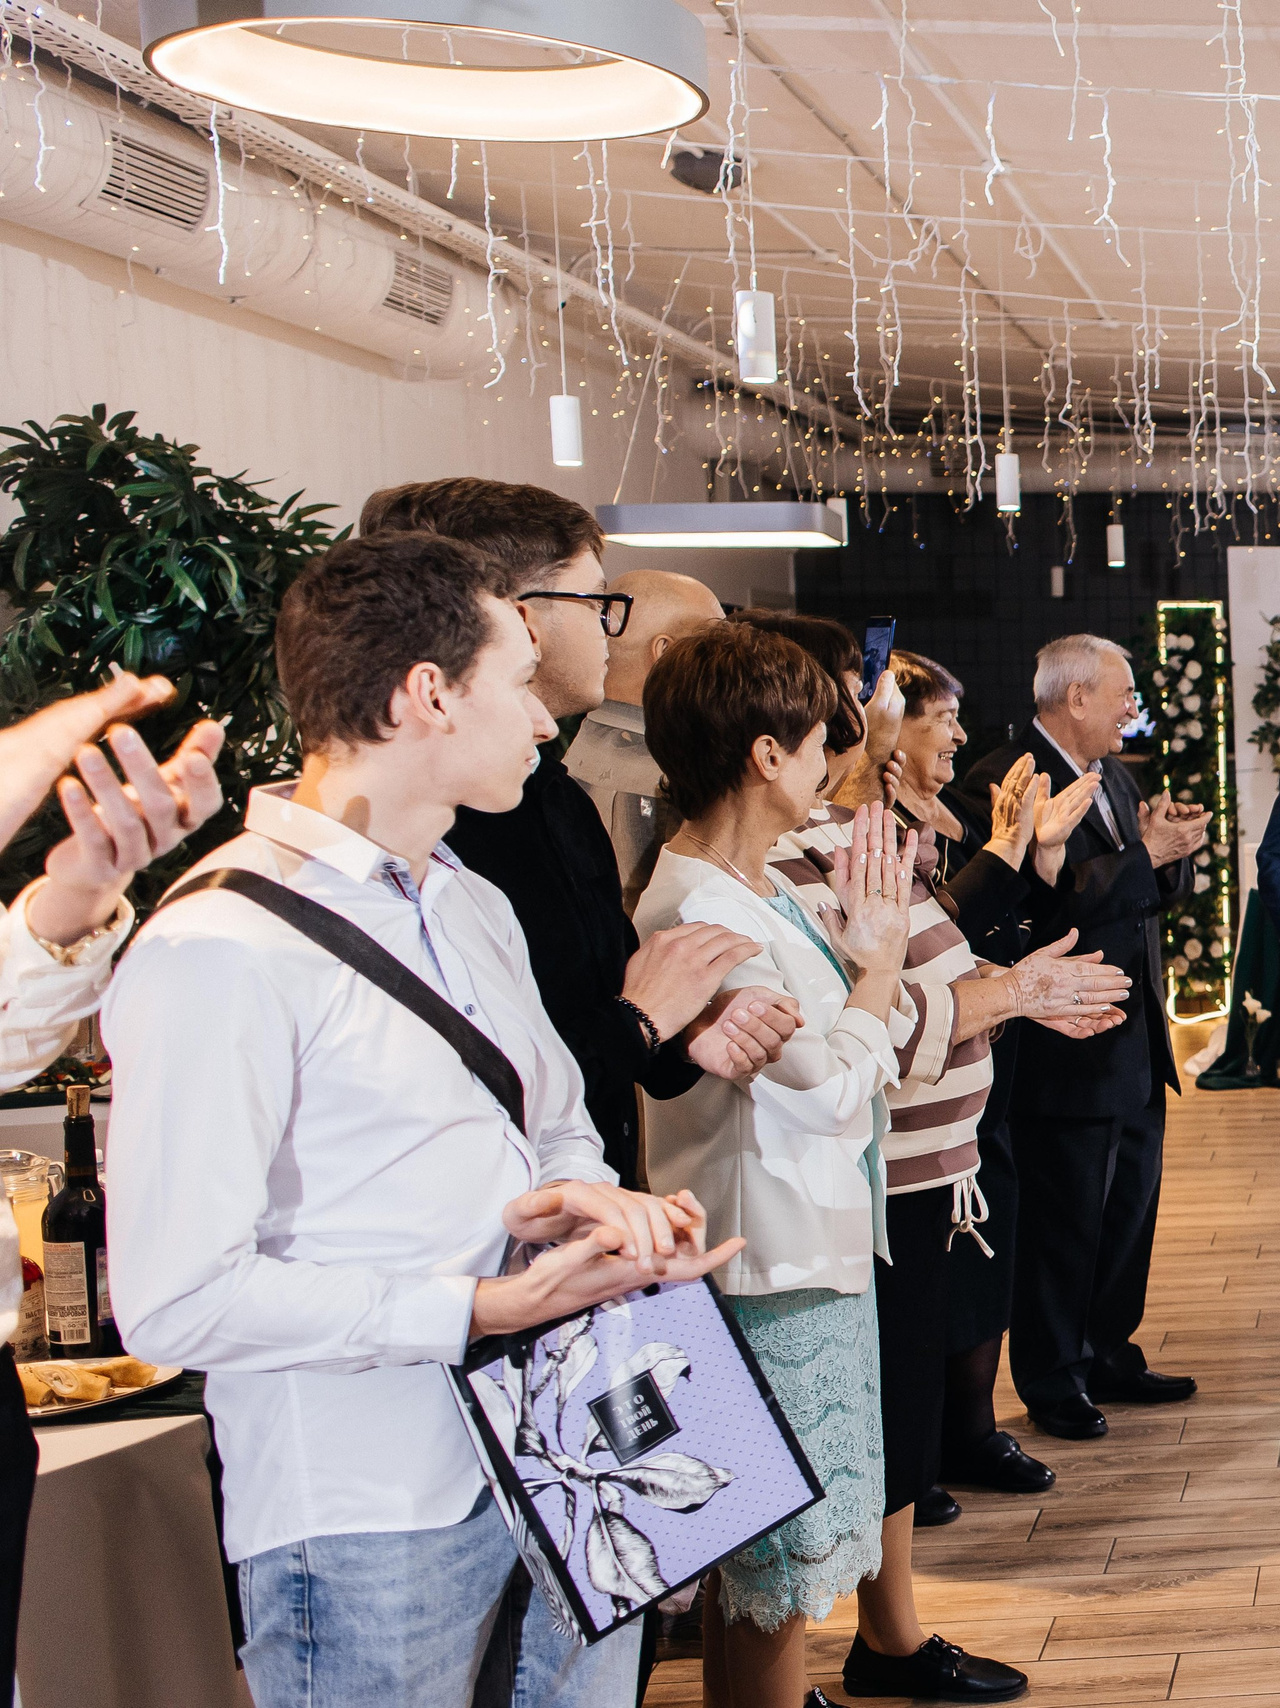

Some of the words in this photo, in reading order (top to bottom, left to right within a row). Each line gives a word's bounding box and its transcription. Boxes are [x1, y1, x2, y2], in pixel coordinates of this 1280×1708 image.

[612, 1394, 645, 1416] ЭТО
[619, 1404, 652, 1428] ТВОЙ
[627, 1418, 659, 1442] ДЕНЬ
